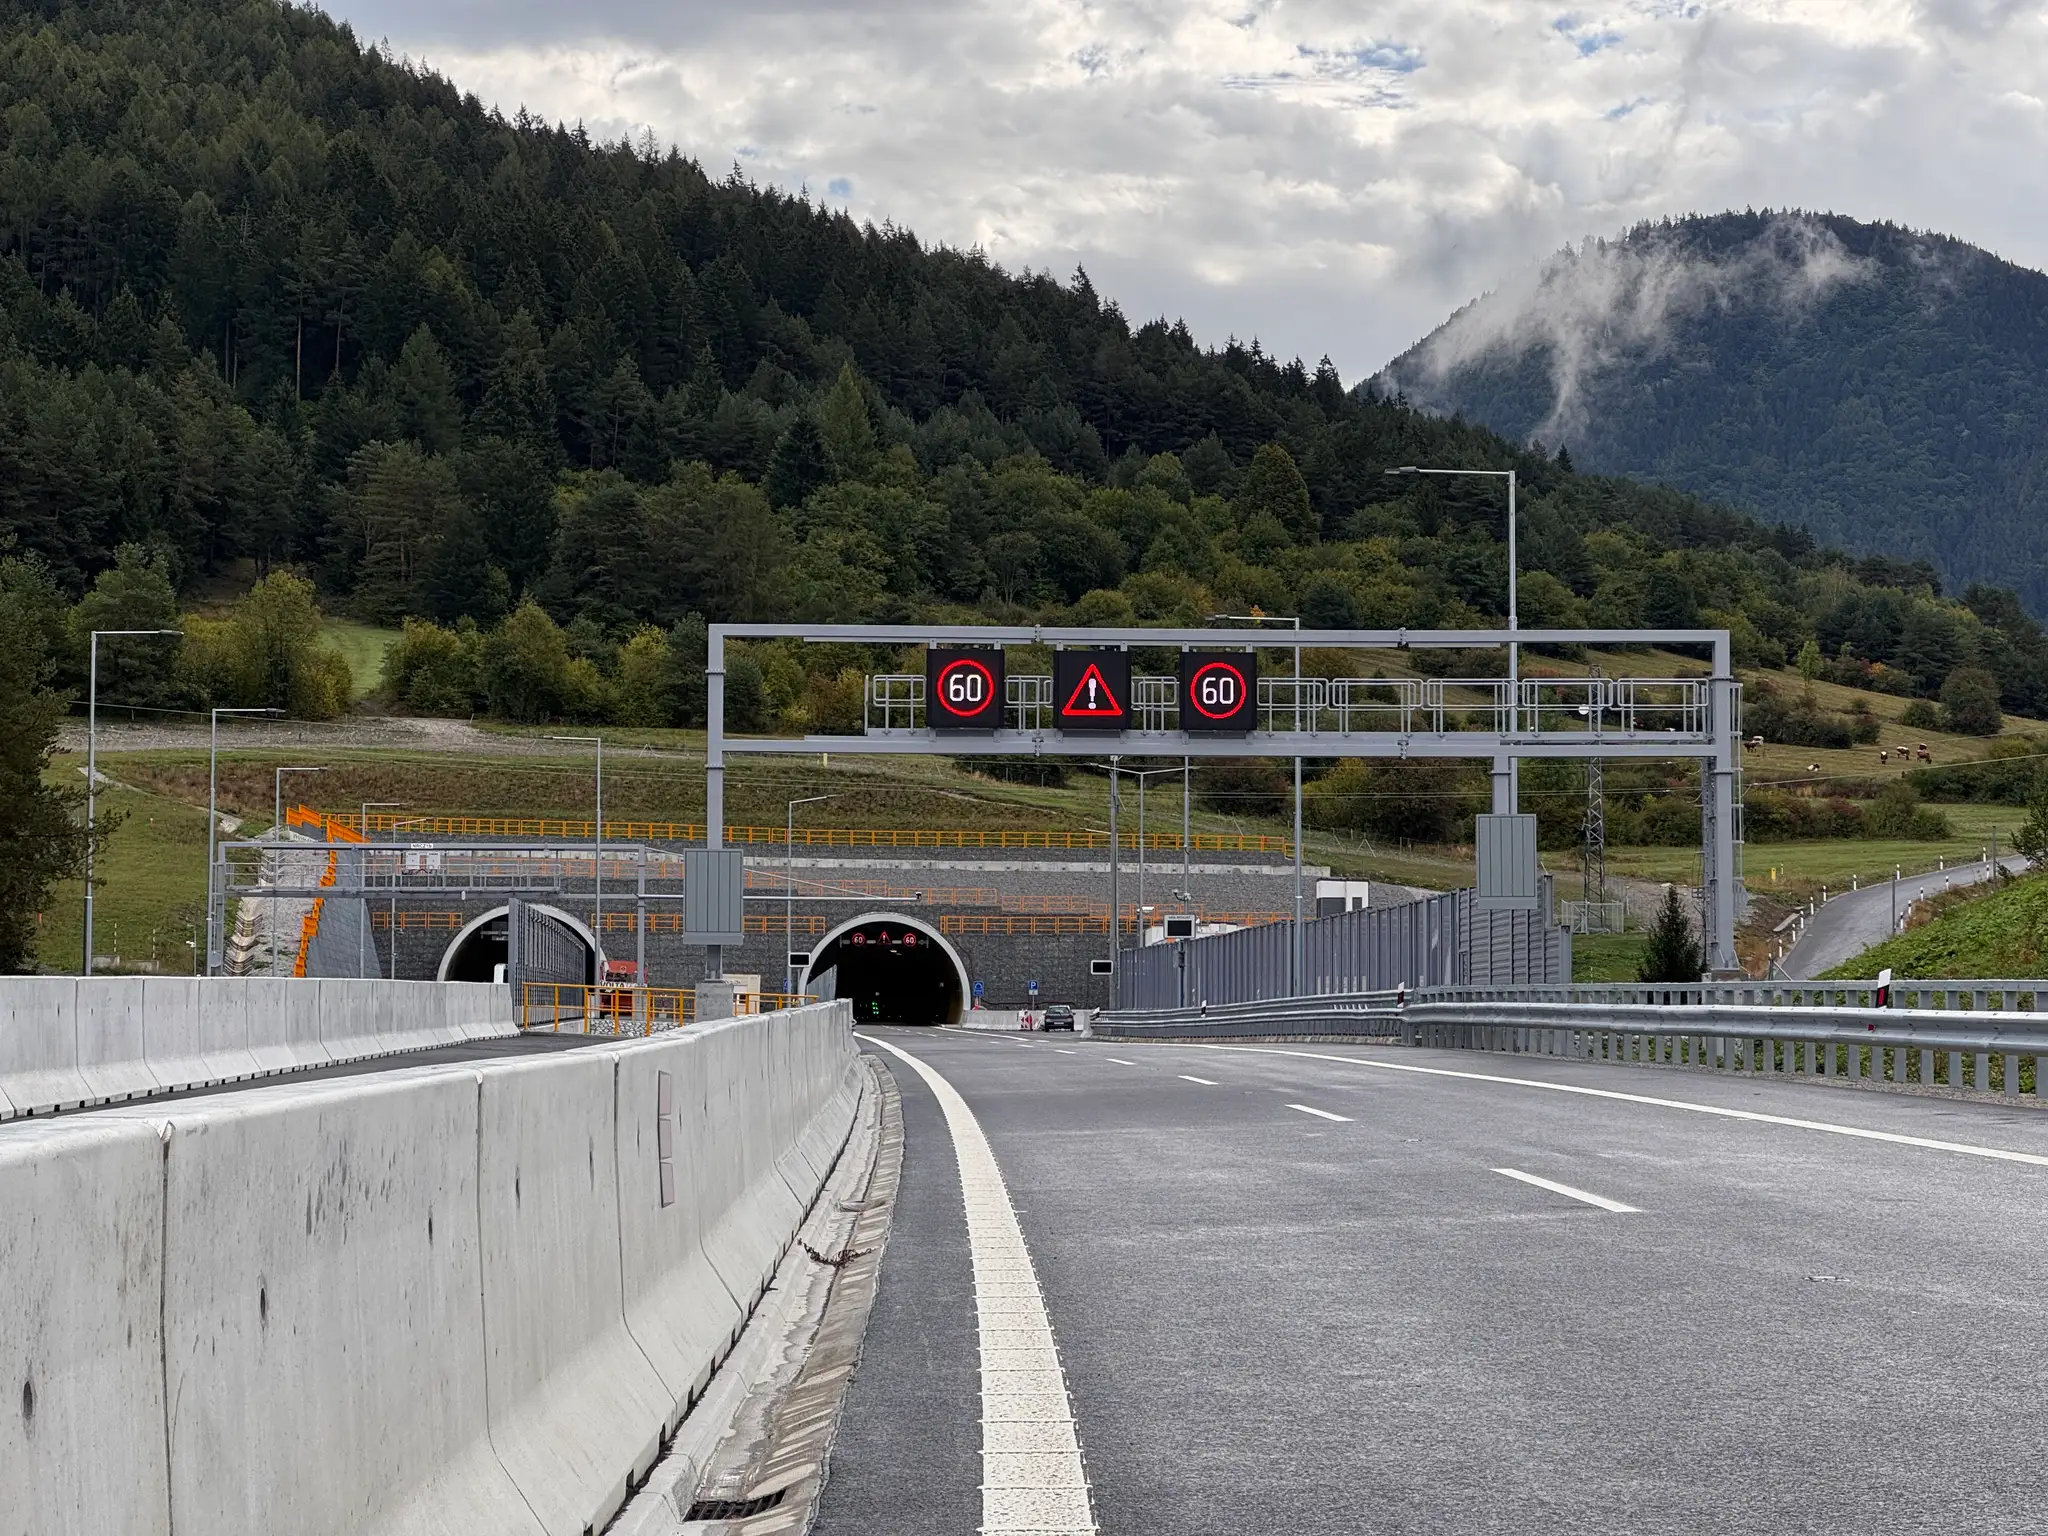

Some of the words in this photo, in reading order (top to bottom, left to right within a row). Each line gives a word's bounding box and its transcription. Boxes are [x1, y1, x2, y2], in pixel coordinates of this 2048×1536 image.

[949, 674, 981, 702] 60
[1202, 677, 1235, 705] 60
[854, 936, 863, 944] 60
[905, 936, 915, 944] 60
